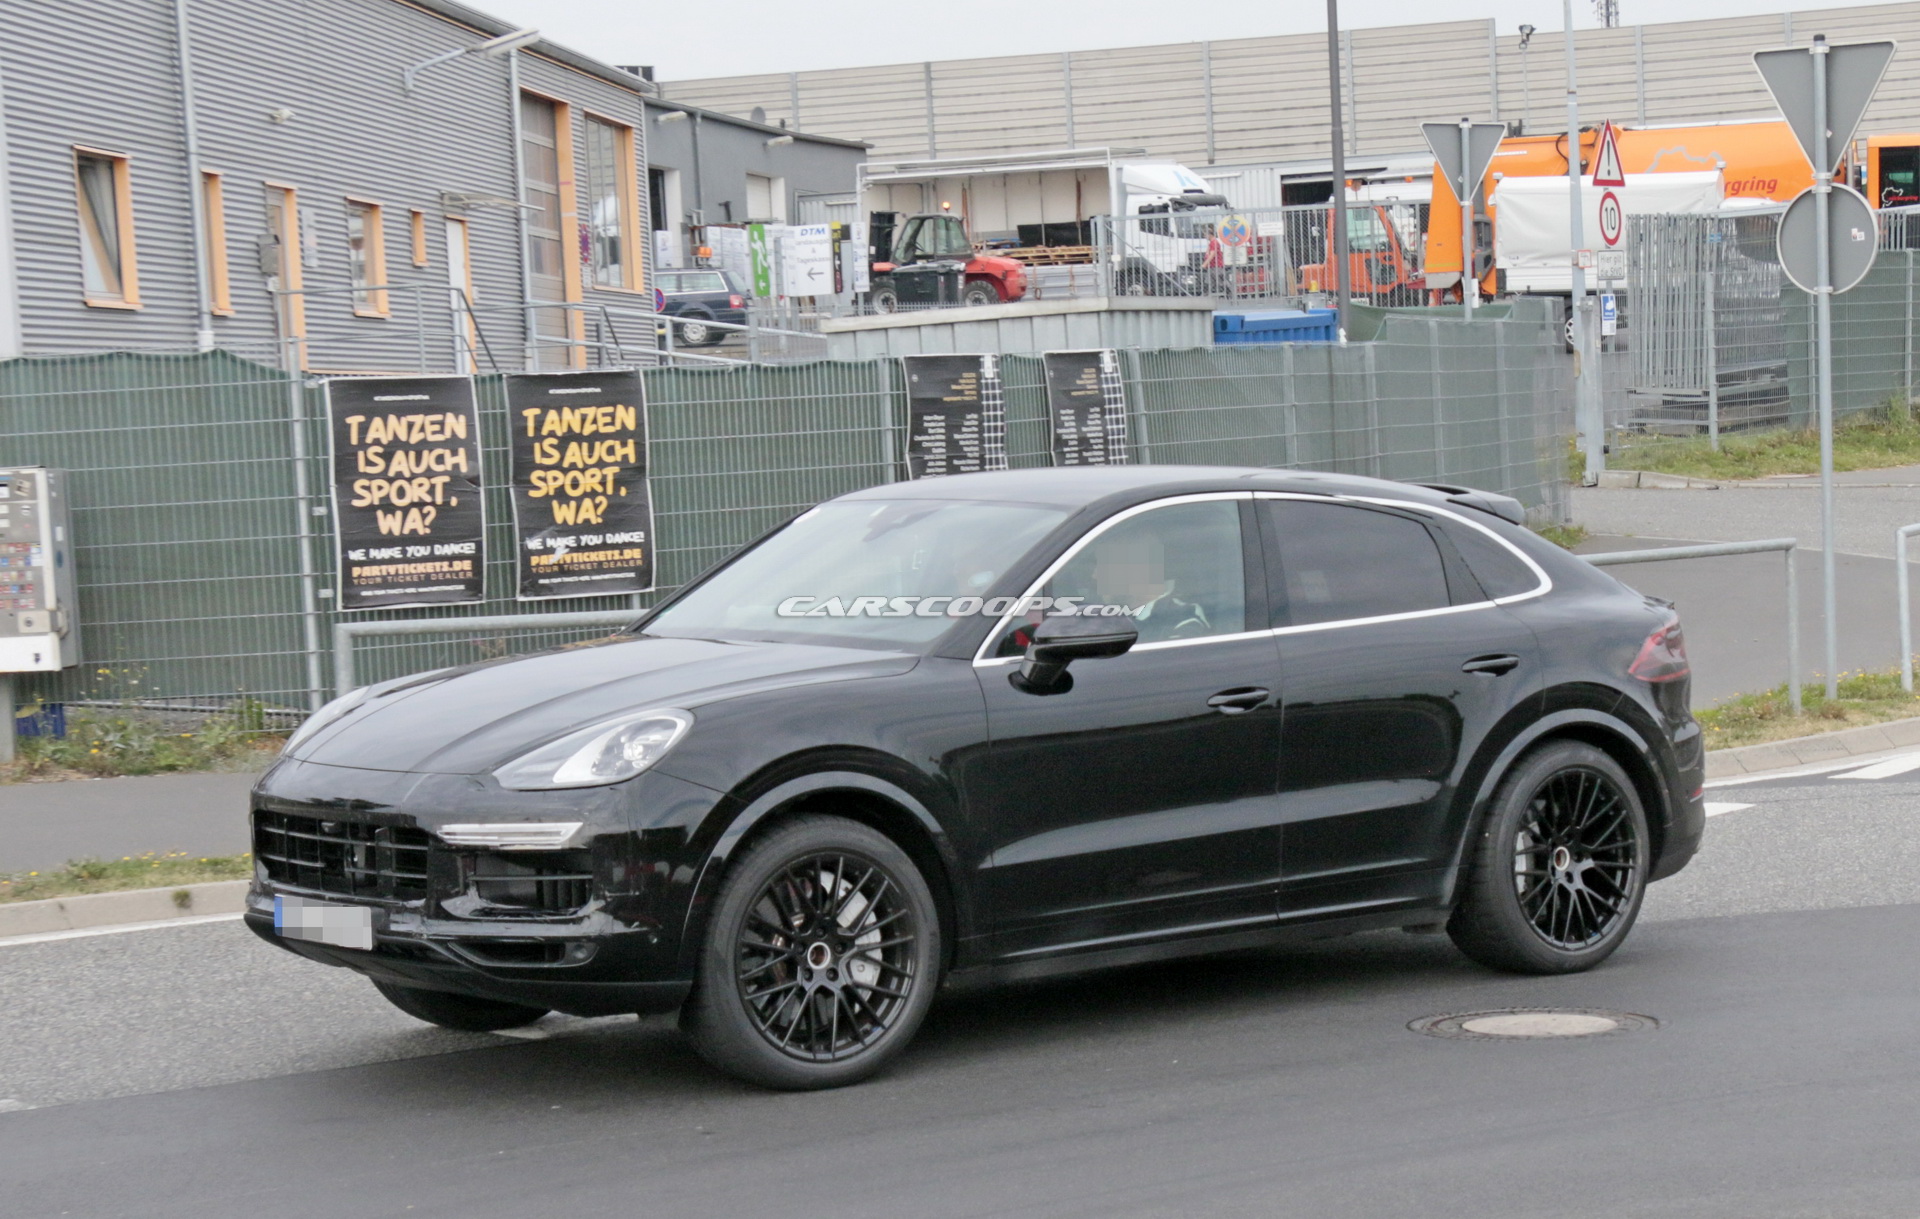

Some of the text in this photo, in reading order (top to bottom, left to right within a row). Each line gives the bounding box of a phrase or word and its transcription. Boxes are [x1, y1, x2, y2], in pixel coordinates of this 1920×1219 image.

[1724, 176, 1778, 196] rgring
[801, 227, 826, 236] DTM
[1605, 207, 1616, 231] 10
[345, 412, 467, 446] TANZEN
[521, 404, 636, 438] TANZEN
[357, 446, 468, 478] IS AUCH
[533, 437, 636, 469] IS AUCH
[351, 475, 458, 507] SPORT,
[528, 466, 627, 498] SPORT,
[376, 505, 437, 537] WA?
[552, 495, 608, 526] WA?
[348, 542, 476, 561] WE MAKE YOU DANCE!
[526, 531, 645, 550] WE MAKE YOU DANCE!
[352, 560, 473, 578] PARTYTICKETS.DE
[352, 571, 474, 586] YOUR TICKET DEALER
[531, 559, 643, 574] YOUR TICKET DEALER
